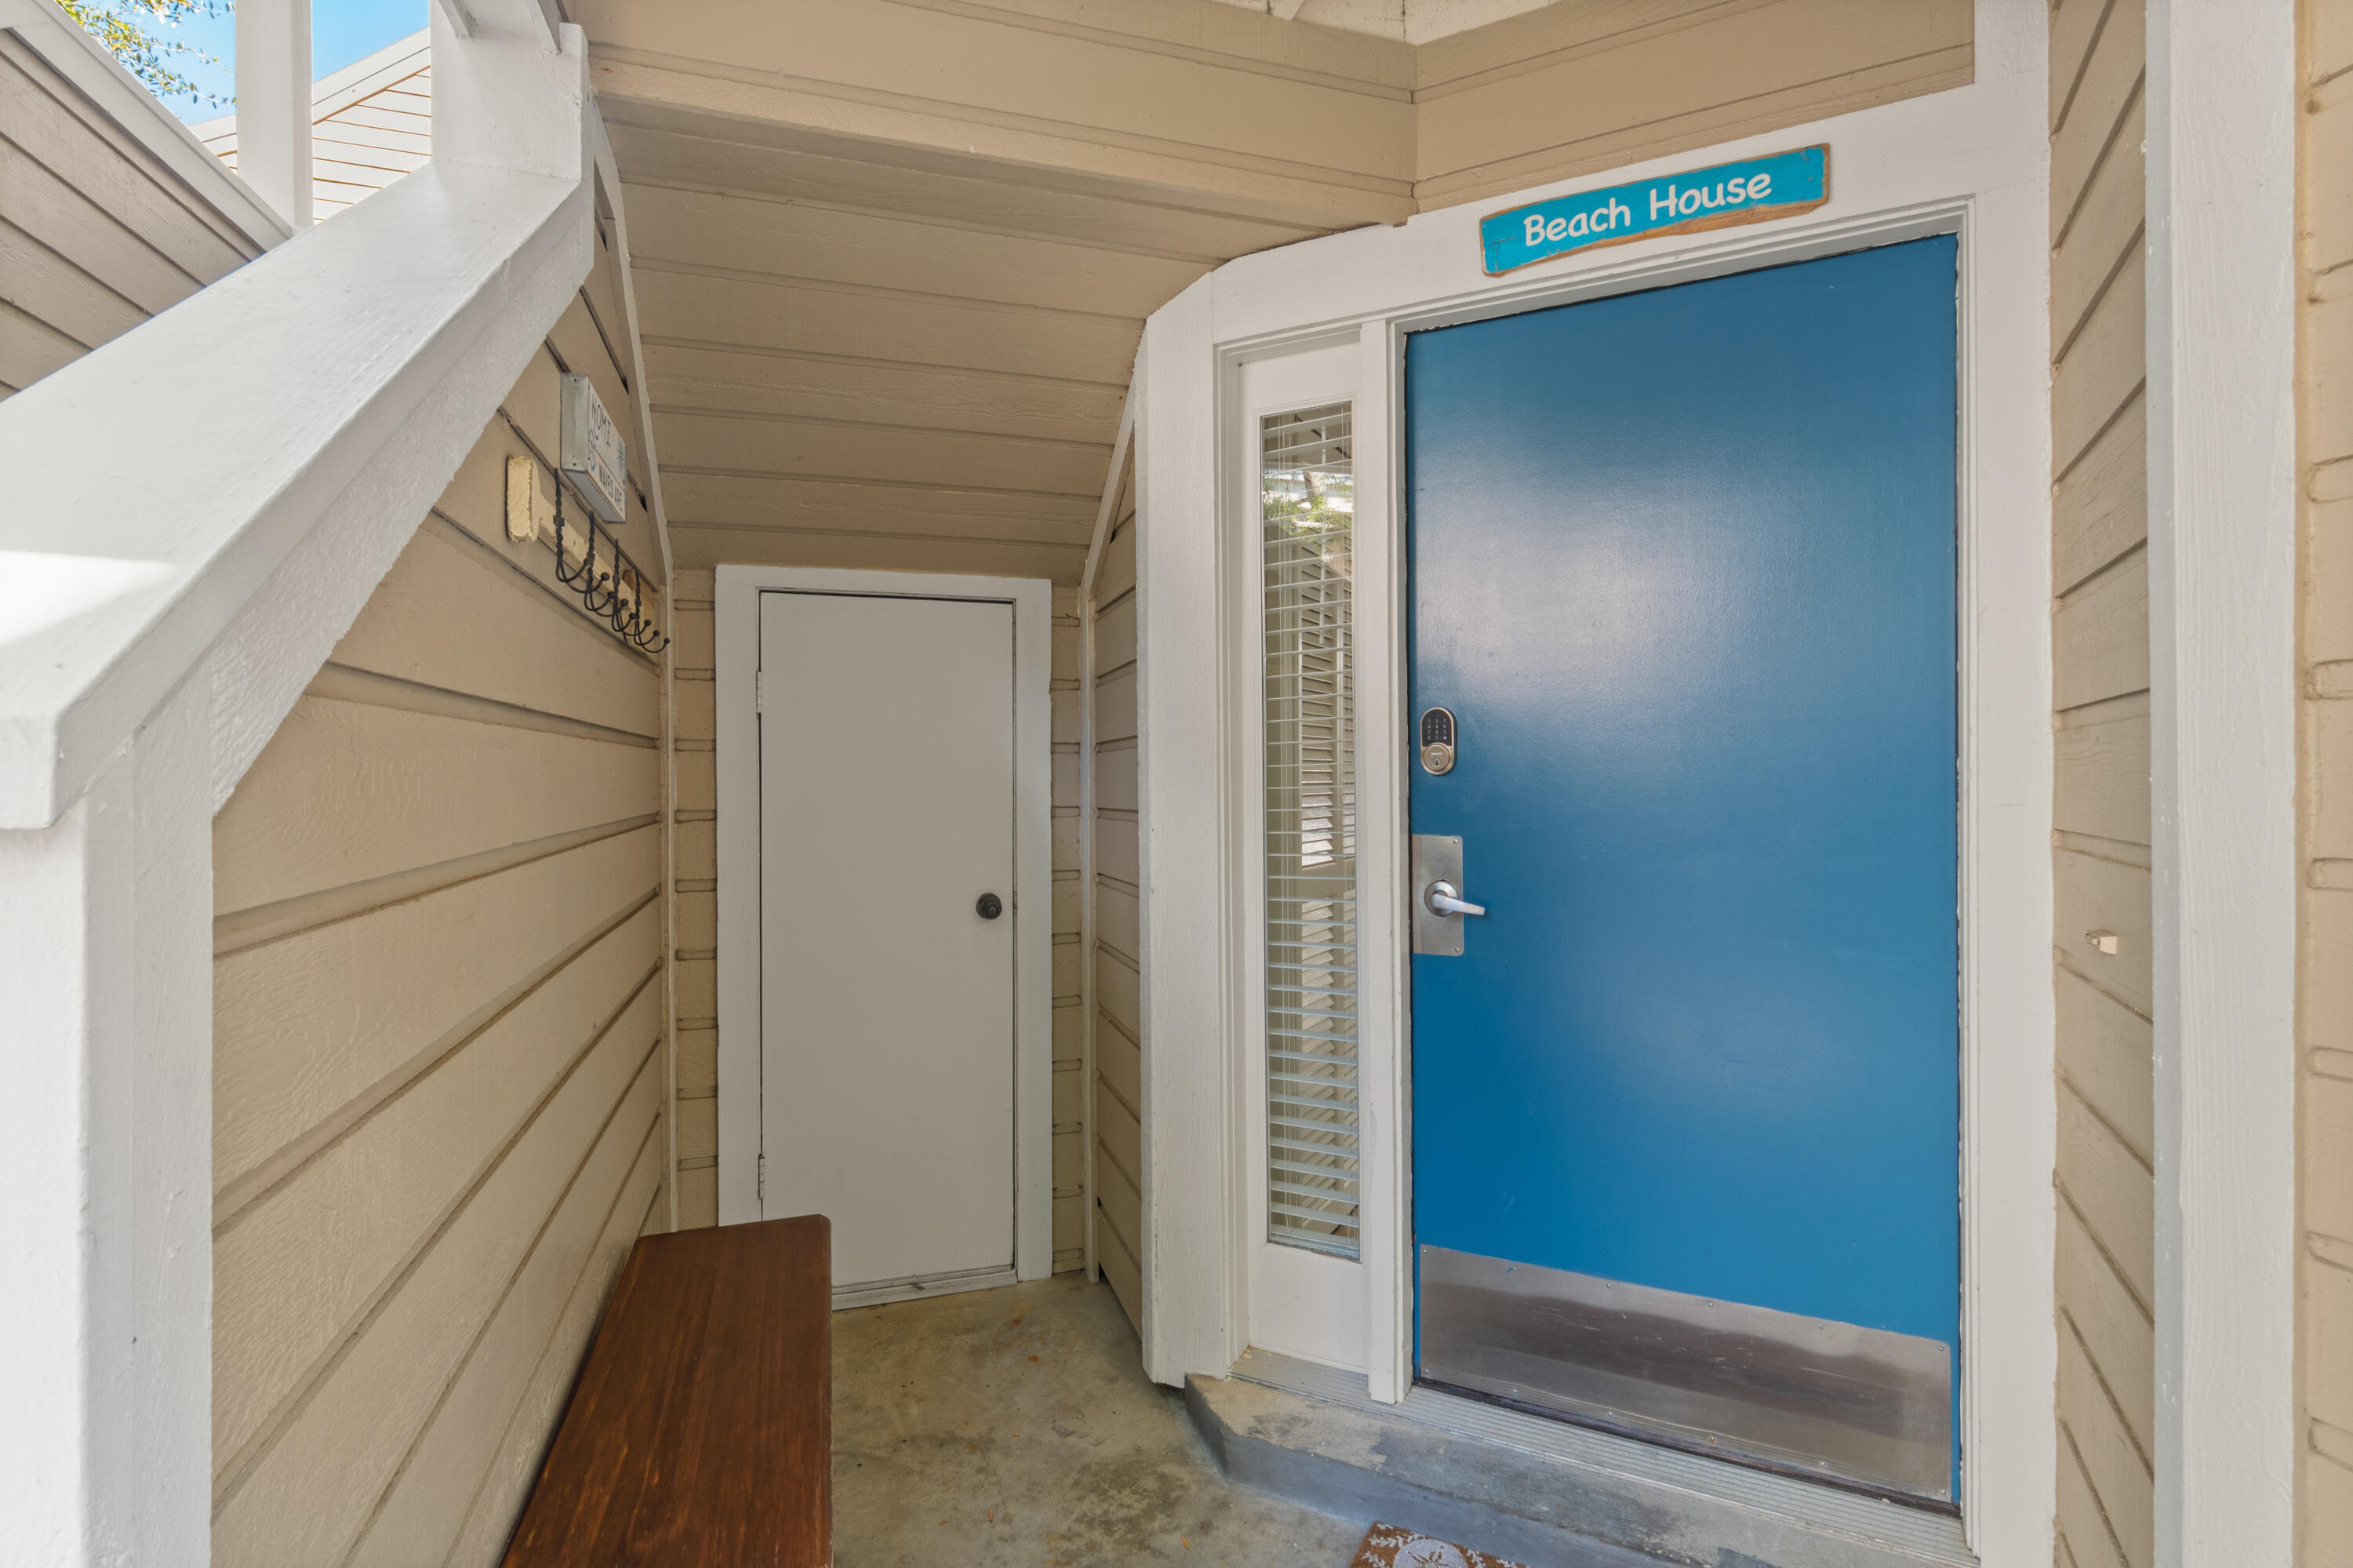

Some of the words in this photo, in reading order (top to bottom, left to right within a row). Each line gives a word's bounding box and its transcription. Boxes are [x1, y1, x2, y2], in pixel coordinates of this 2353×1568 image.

[1523, 197, 1631, 247] Beach
[1649, 173, 1772, 221] House
[591, 393, 611, 448] HOME
